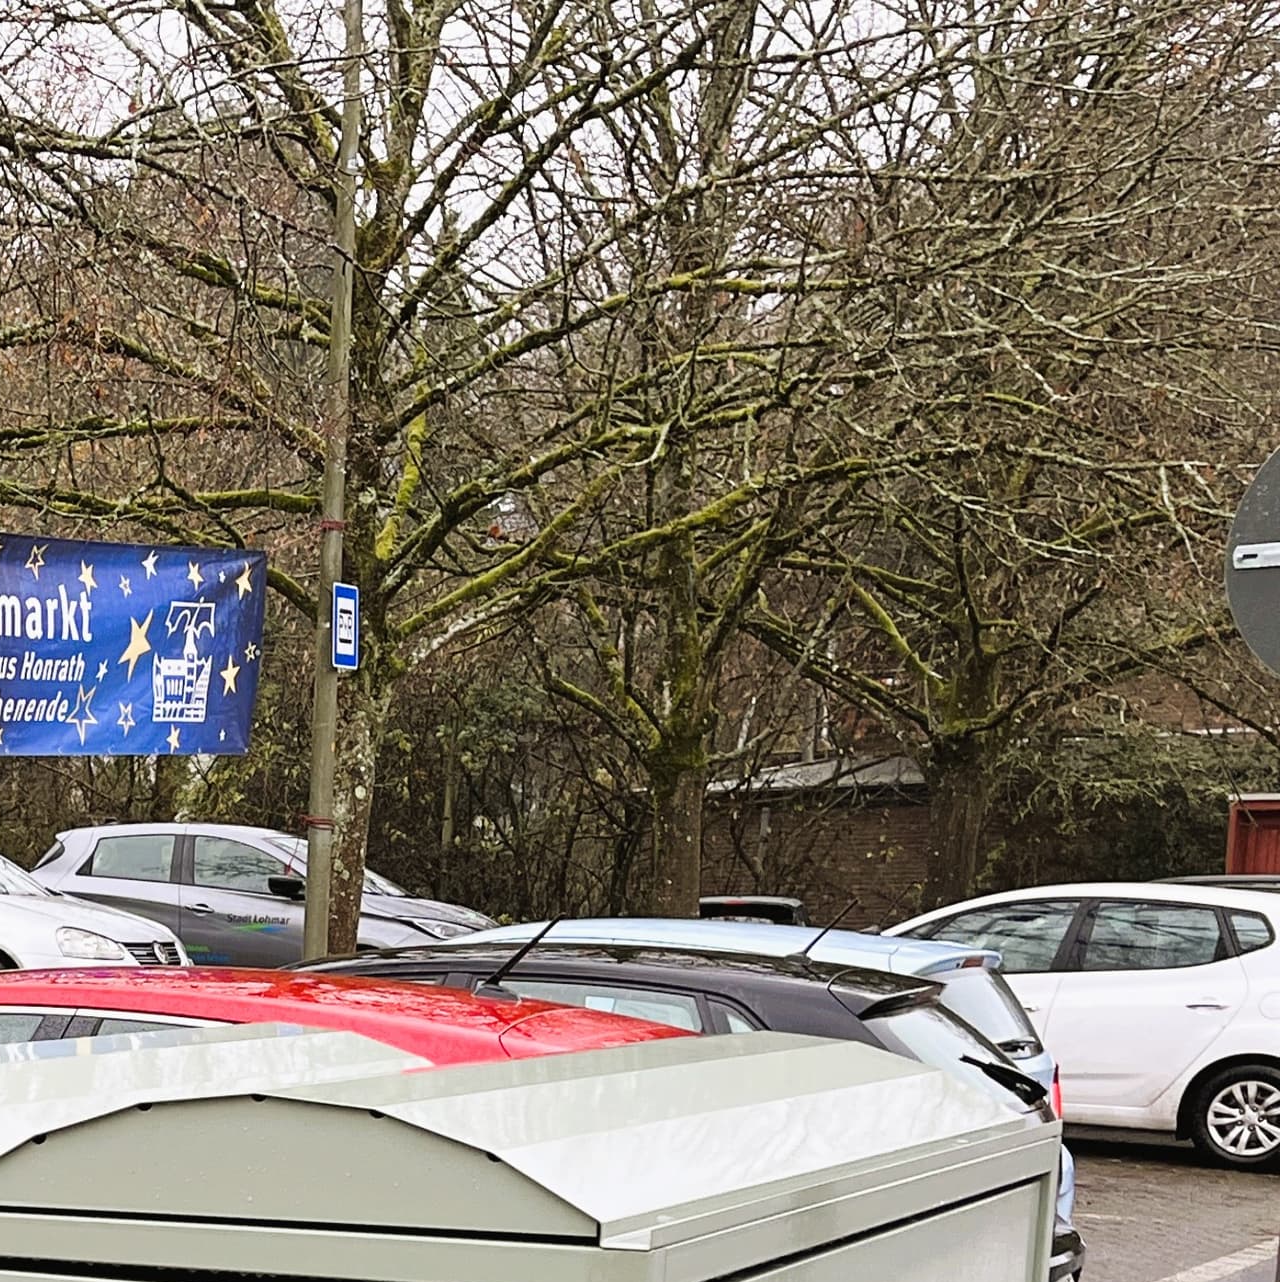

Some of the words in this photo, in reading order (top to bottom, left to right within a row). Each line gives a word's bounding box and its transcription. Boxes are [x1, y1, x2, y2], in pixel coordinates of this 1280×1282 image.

[20, 652, 86, 682] Honrath
[227, 913, 252, 924] Stadt
[253, 914, 291, 926] Lohmar
